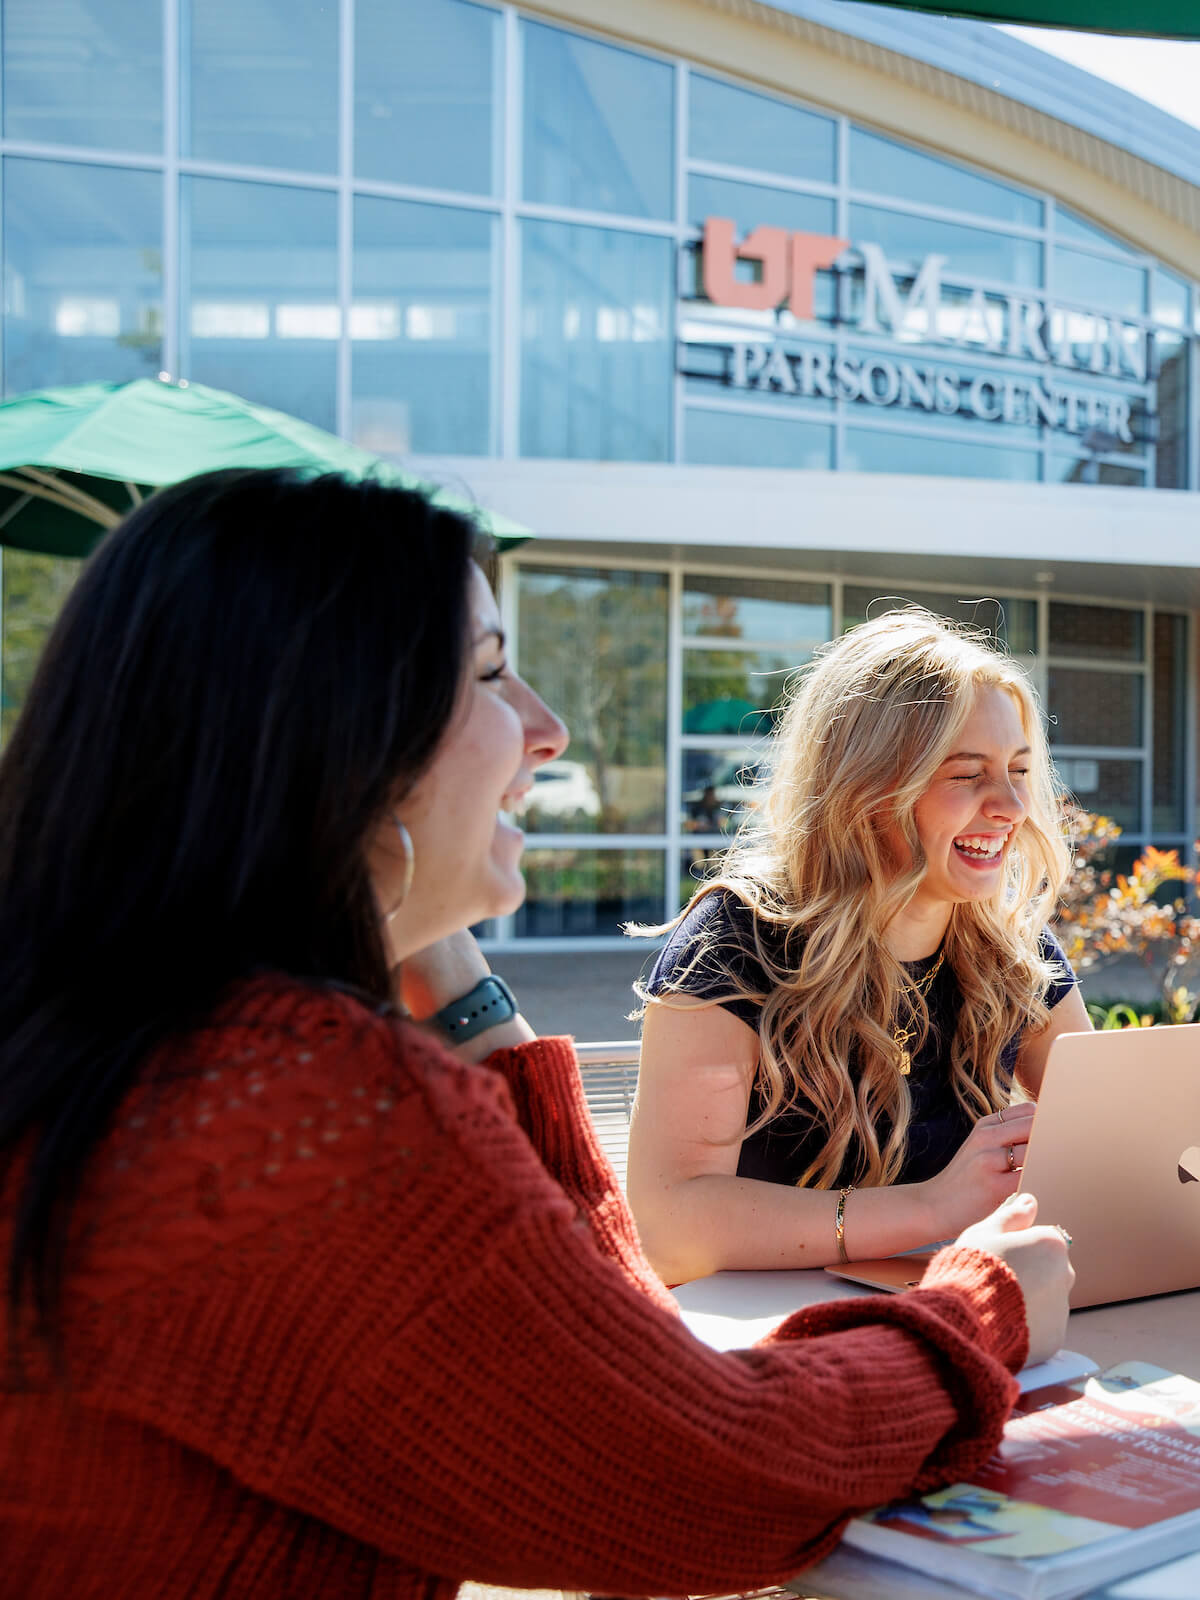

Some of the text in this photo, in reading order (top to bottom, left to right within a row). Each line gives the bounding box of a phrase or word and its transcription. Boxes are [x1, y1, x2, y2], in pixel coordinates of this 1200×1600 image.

[854, 242, 1147, 382] MARTIN
[730, 341, 1134, 444] PARSONS CENTER
